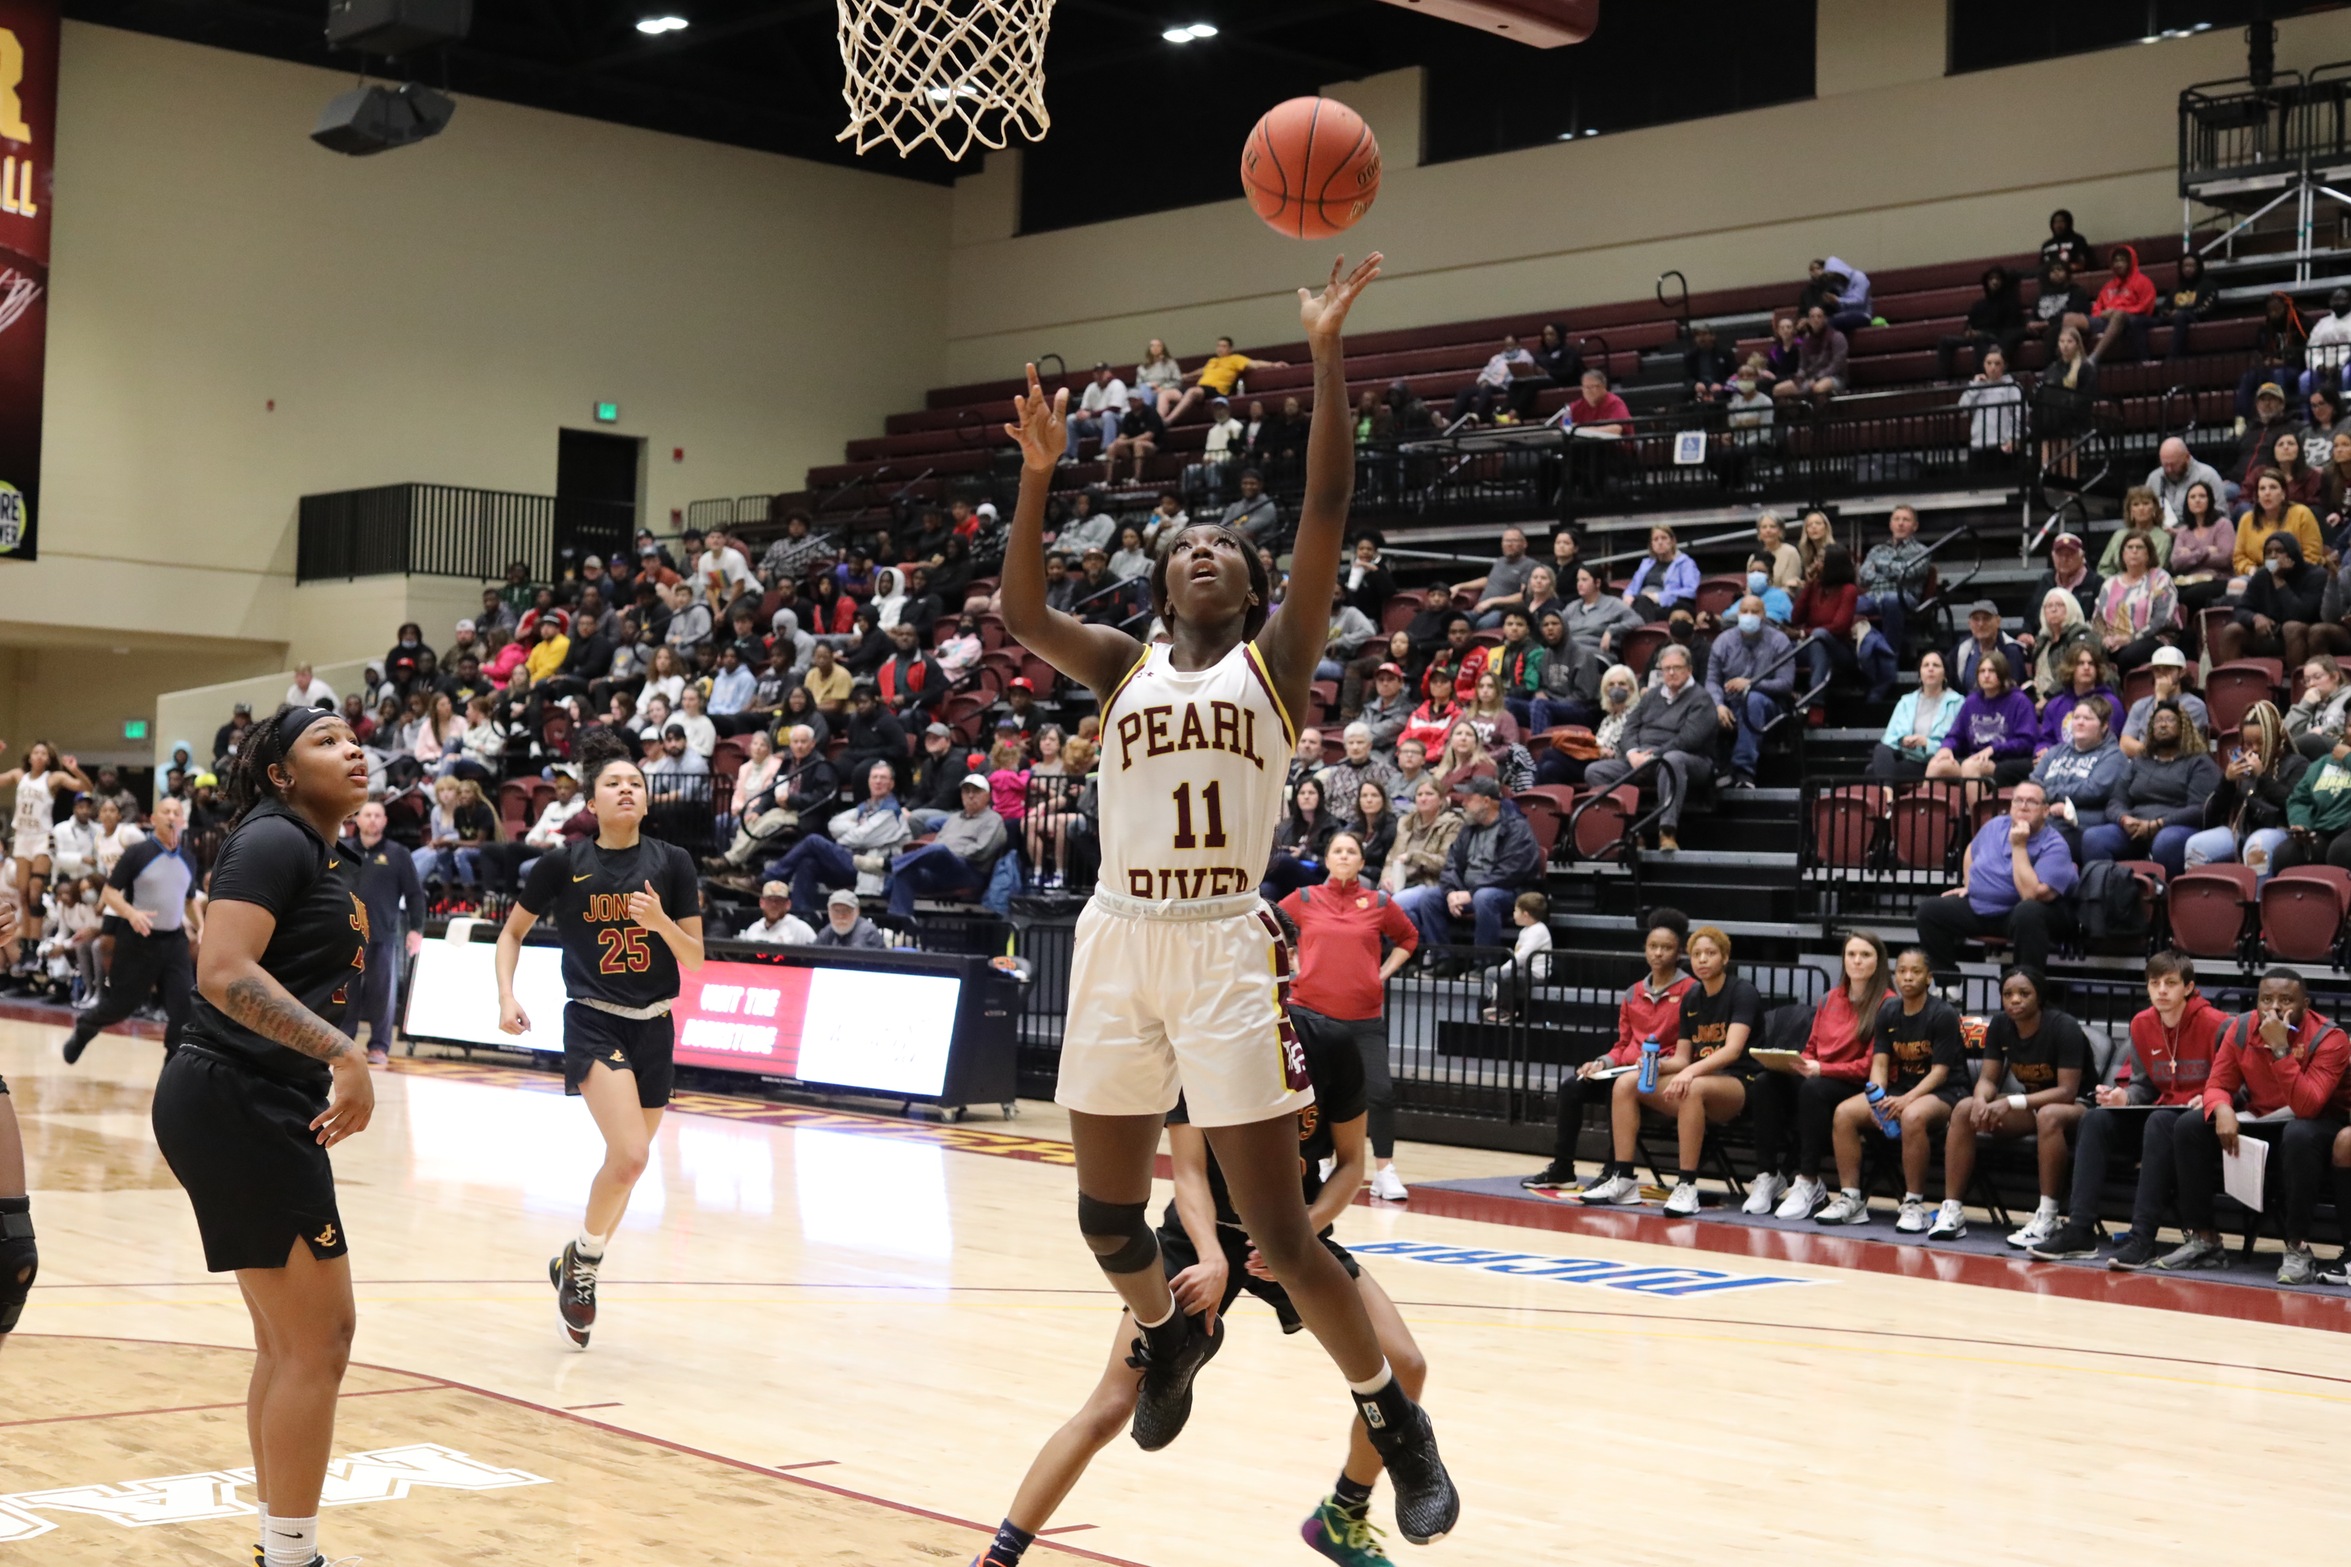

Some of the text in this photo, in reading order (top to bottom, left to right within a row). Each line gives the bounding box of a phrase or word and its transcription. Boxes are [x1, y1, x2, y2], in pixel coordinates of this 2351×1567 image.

[1117, 700, 1264, 772] PEARL
[1172, 779, 1227, 850] 11
[583, 892, 634, 923] JON
[597, 926, 651, 975] 25
